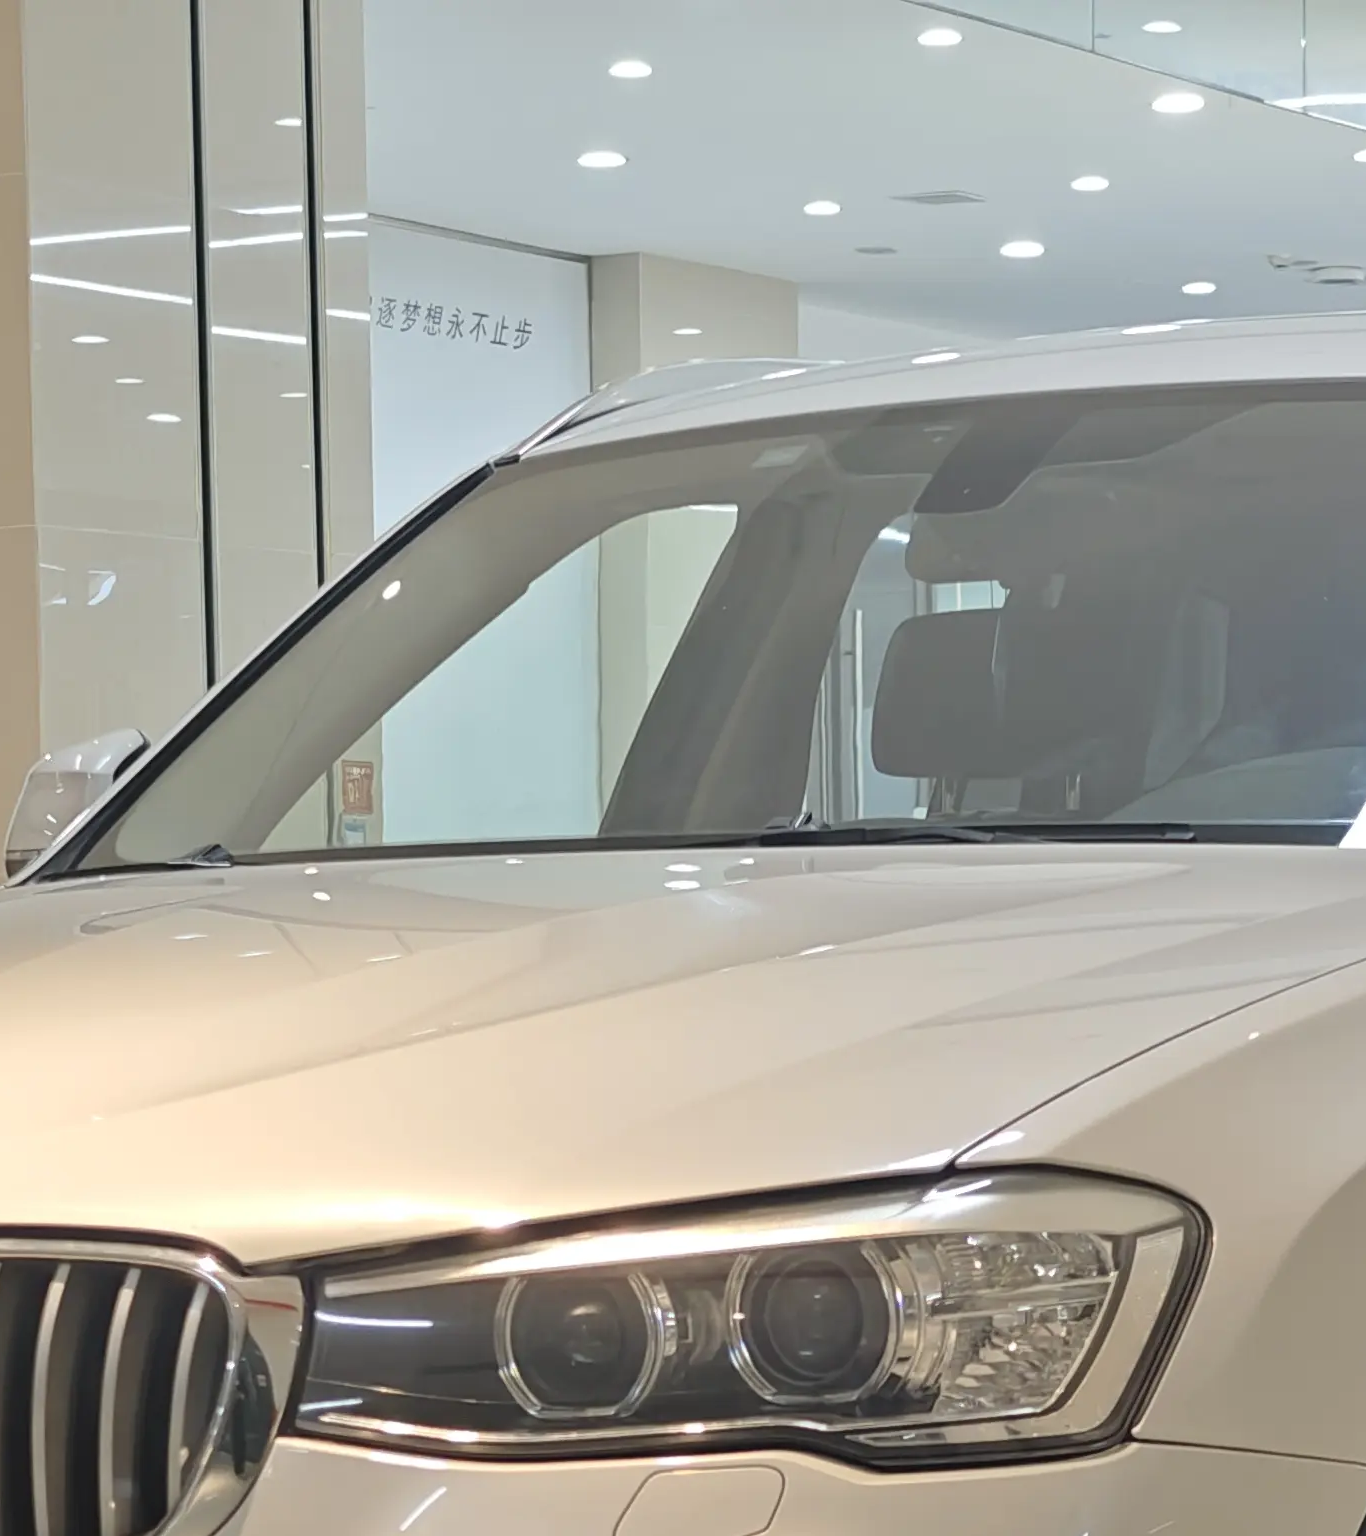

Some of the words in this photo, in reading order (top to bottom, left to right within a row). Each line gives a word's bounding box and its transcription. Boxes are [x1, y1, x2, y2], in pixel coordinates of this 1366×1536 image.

[370, 296, 533, 351] 逐梦想永不止步
